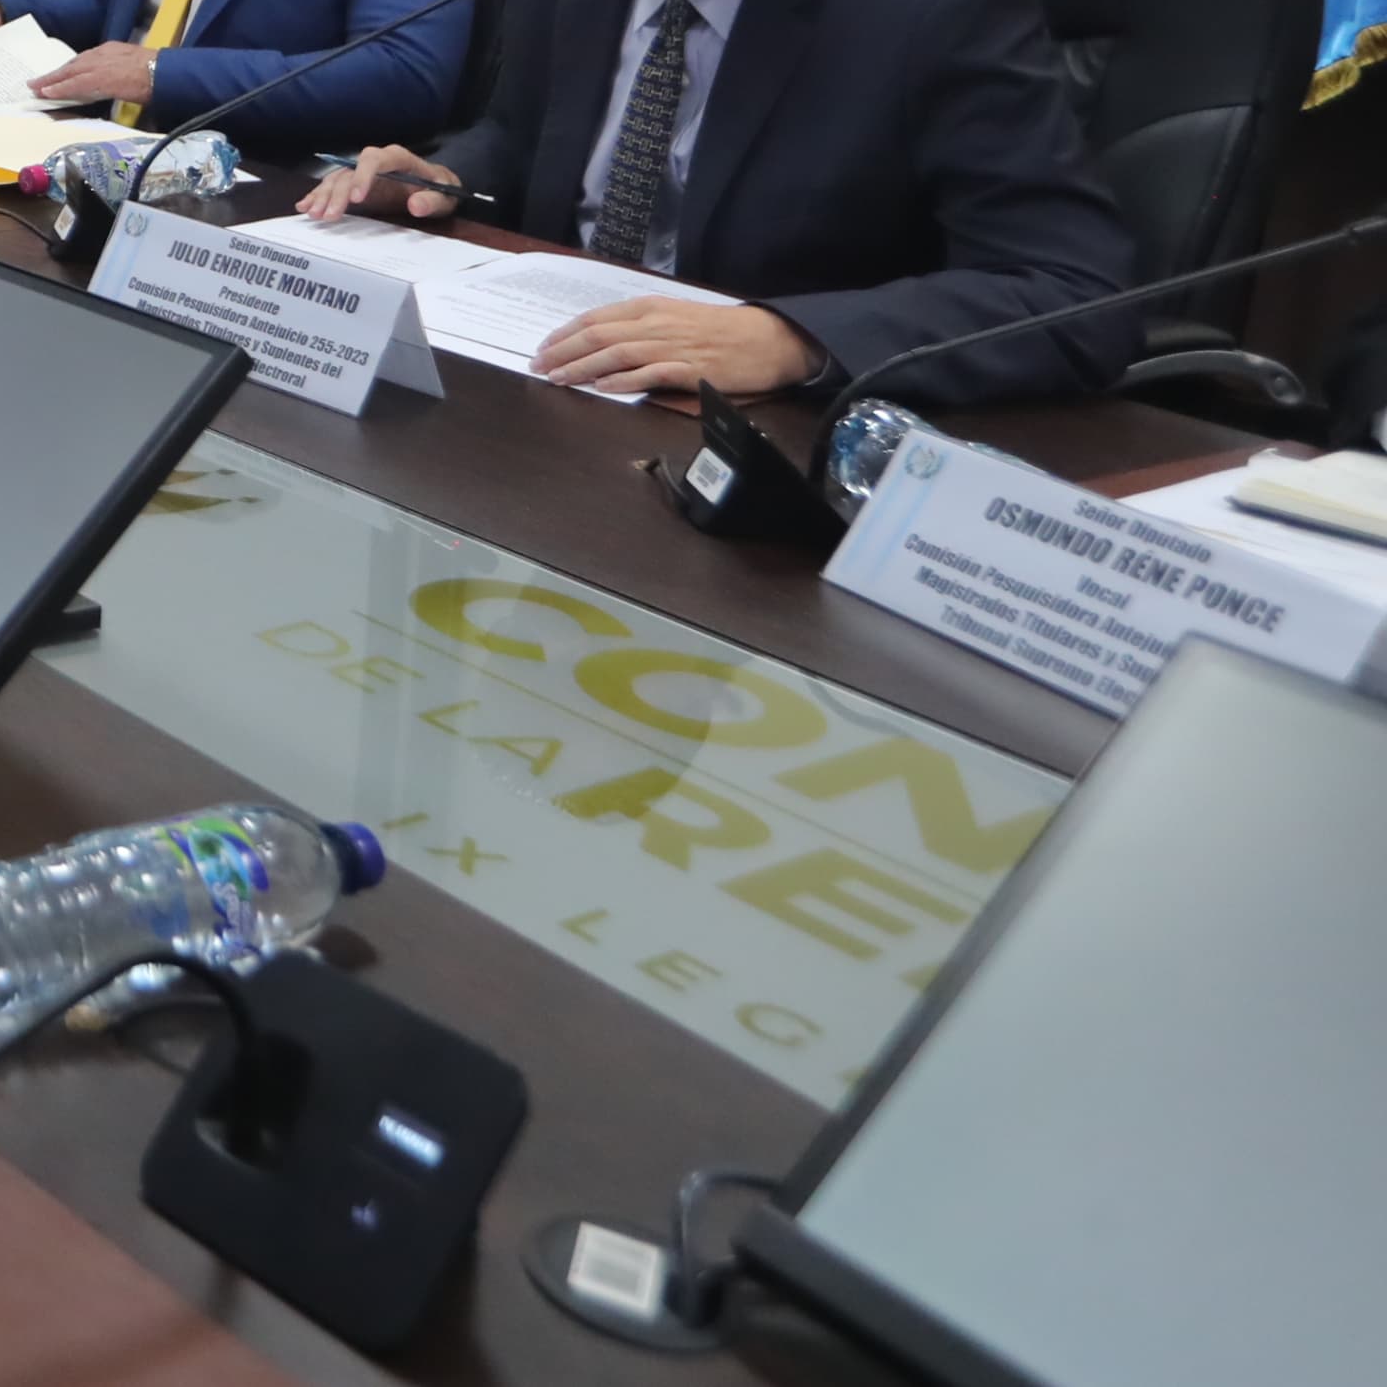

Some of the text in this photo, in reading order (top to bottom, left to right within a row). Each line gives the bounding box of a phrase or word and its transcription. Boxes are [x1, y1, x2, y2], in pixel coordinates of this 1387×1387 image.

[167, 239, 361, 314] JULIO ENRIQUE MONTANO
[228, 236, 310, 271] Señor Diputado
[127, 276, 370, 366] Comisión Pesquisidora Antejuicio 255-2023
[218, 285, 281, 316] Presidente
[260, 339, 320, 372] Suplentes
[321, 361, 343, 379] del
[984, 496, 1114, 566] OSMUNDO
[1184, 573, 1286, 634] PONCE
[1074, 498, 1212, 564] Señor Diputado
[904, 532, 981, 579] Comisión
[981, 565, 1100, 628] Pesquisidora
[915, 565, 1019, 624] Magistrados
[1024, 610, 1102, 660] Titulares
[1075, 574, 1132, 611] Vocal
[940, 604, 1012, 650] Tribunal
[1011, 634, 1095, 686] Supremo
[254, 621, 564, 777] DE LA
[549, 766, 971, 990] RE
[382, 811, 863, 1090] IX LEG
